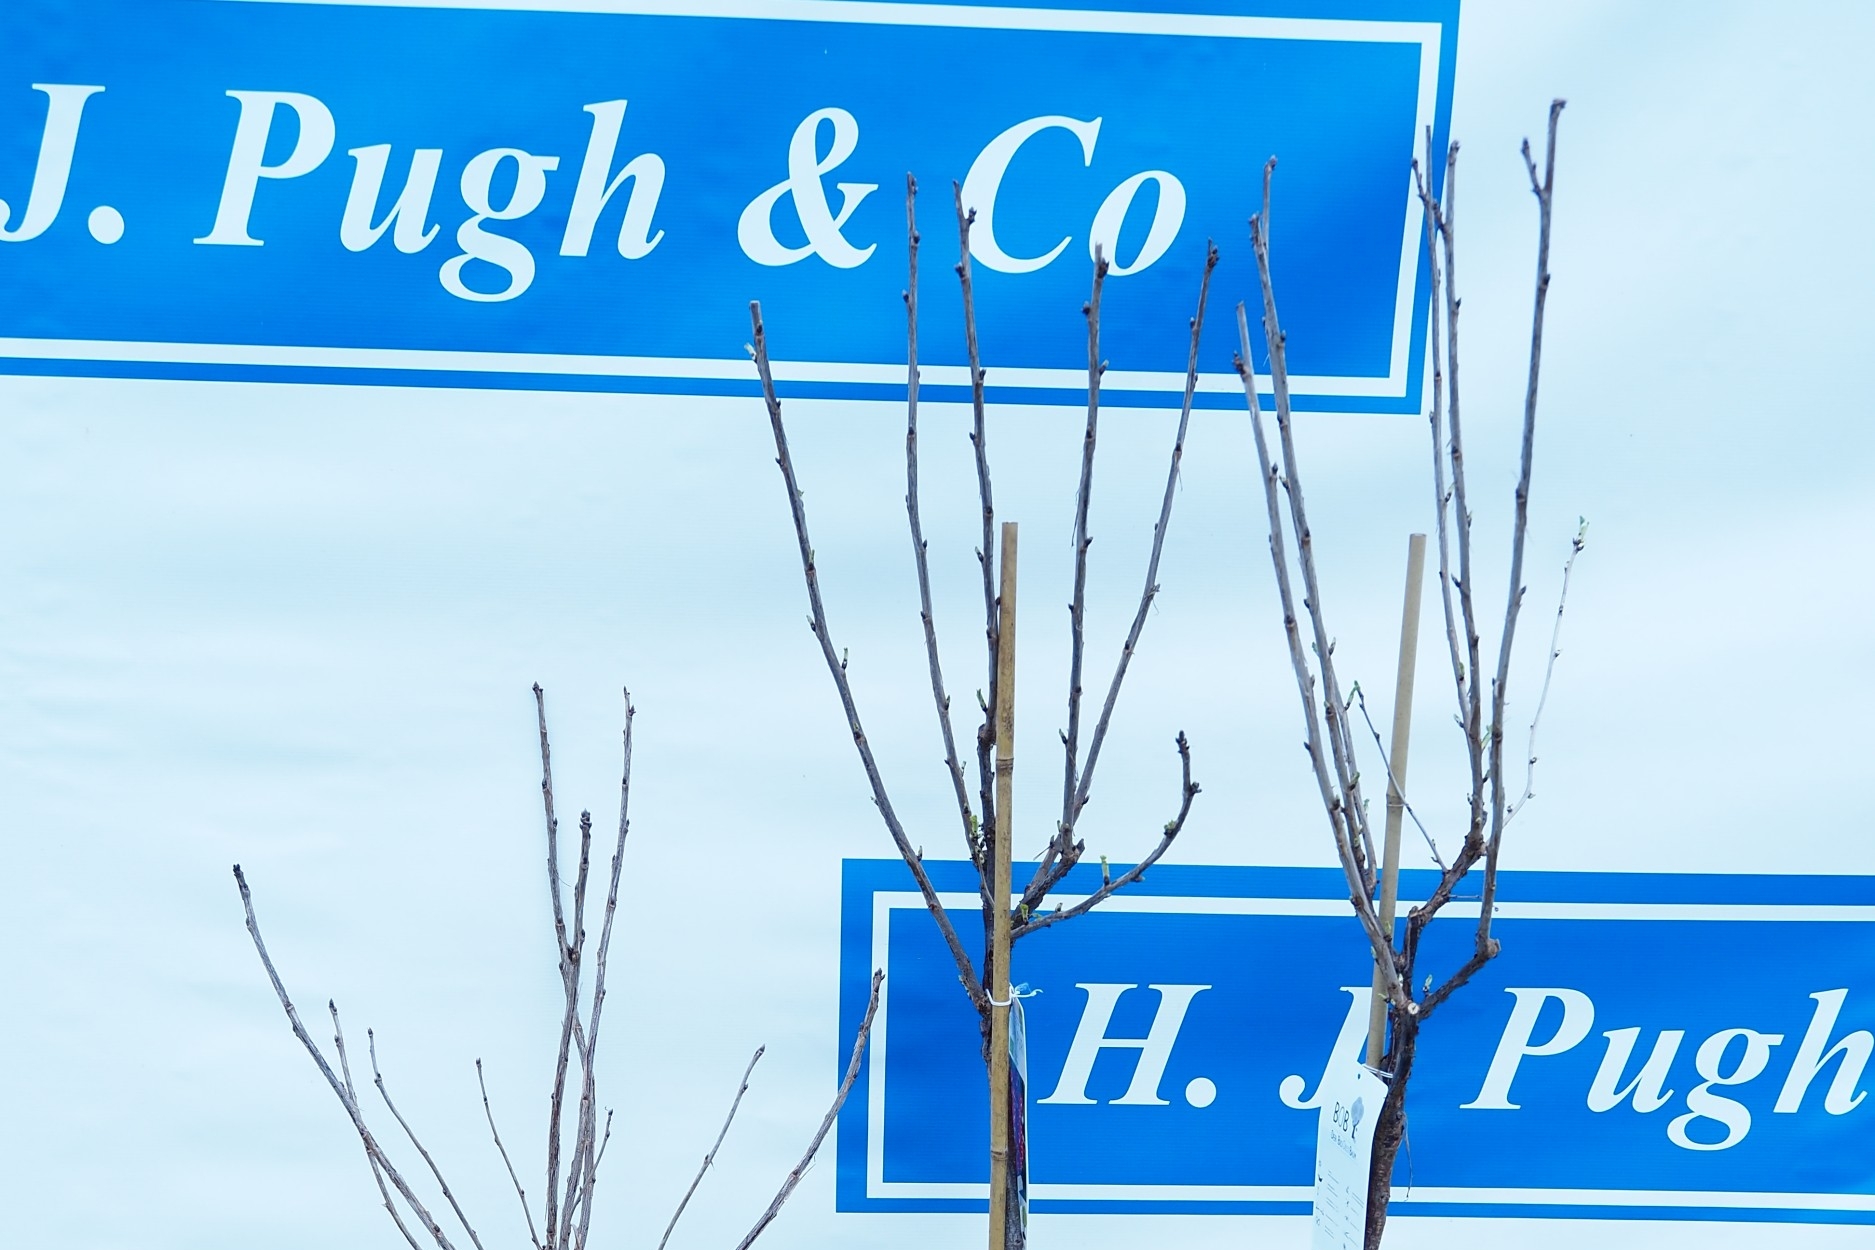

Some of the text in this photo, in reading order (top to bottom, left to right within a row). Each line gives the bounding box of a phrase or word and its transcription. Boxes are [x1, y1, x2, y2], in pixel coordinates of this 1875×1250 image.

[0, 83, 1186, 302] J. Pugh & Co
[1036, 983, 1875, 1151] H. J Pugh
